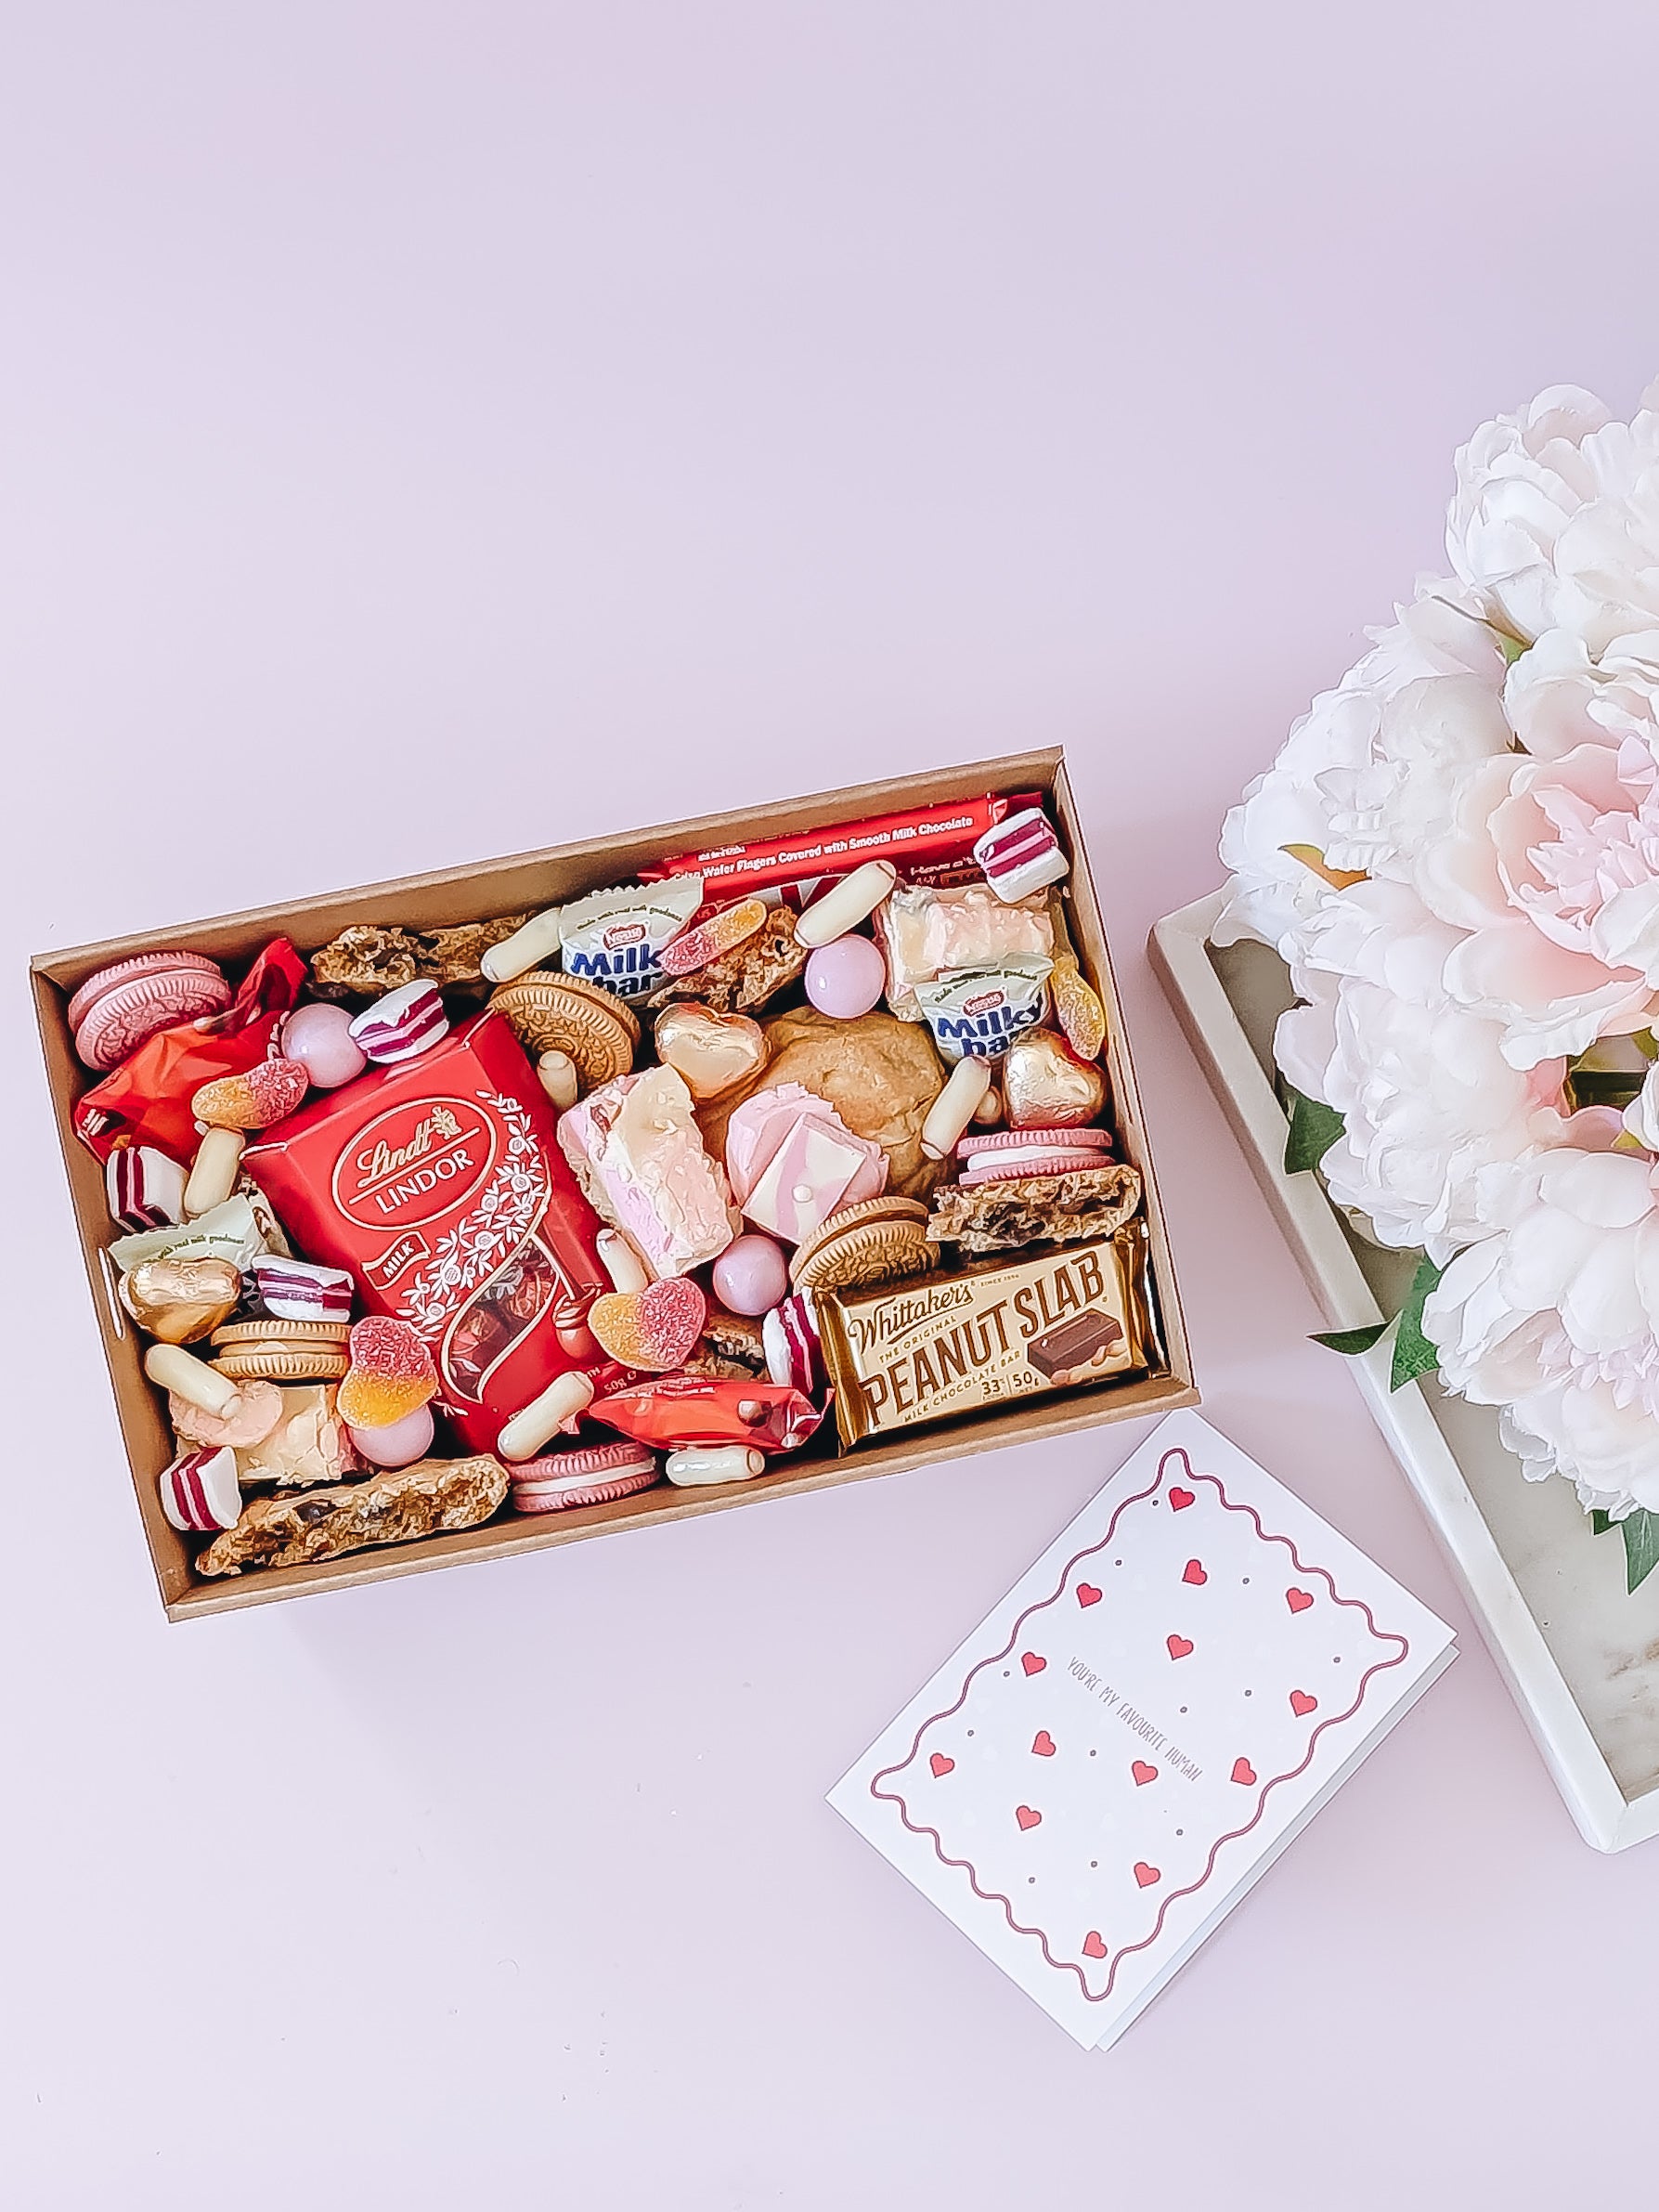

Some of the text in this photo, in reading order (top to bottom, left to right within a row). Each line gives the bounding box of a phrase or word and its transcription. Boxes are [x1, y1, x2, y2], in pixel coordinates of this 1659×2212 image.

[736, 853, 777, 871] Fingers
[778, 845, 823, 864] Covered
[823, 842, 848, 855] with
[849, 833, 891, 850] Smooth
[892, 826, 918, 841] Milk
[918, 816, 973, 836] Chocolate
[570, 943, 663, 976] Milk
[937, 991, 1043, 1039] Milky
[960, 1026, 1023, 1058] ba
[356, 1119, 435, 1189] Lindt
[375, 1150, 474, 1214] LINDOR
[382, 1240, 415, 1279] MILK
[848, 1283, 974, 1355] Whittaker's
[858, 1250, 1105, 1426] PEANUT SLAB
[879, 1316, 957, 1363] THE ORIGINAL
[904, 1351, 1020, 1423] MILK CHOCOLATE BAR
[1067, 1656, 1203, 1782] YOU'RE MY FAVOURITE HUMAN
